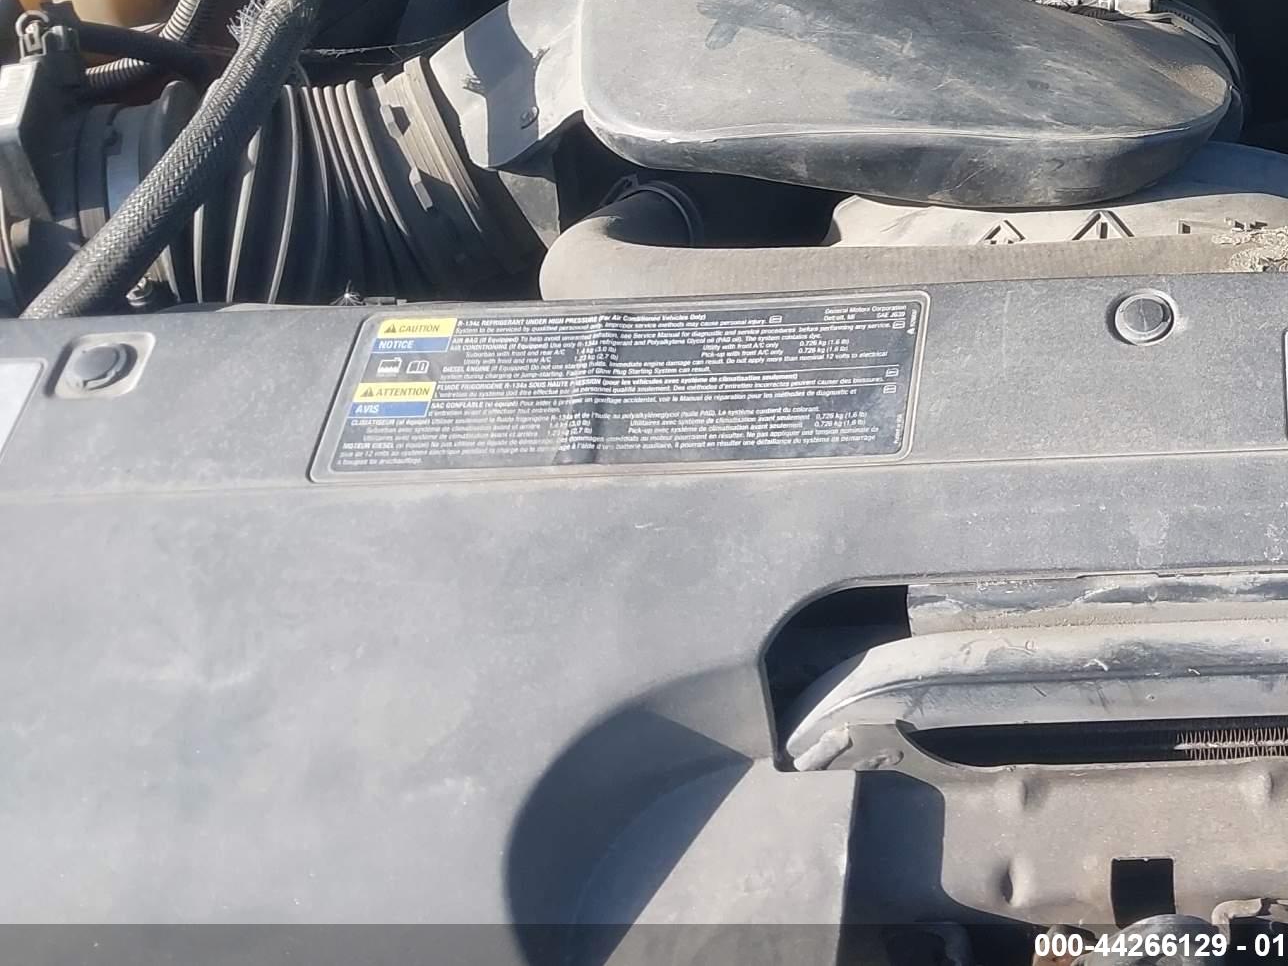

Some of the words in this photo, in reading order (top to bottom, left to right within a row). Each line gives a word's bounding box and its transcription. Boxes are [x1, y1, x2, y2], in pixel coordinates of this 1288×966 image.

[398, 324, 440, 333] CAUTION
[378, 340, 414, 349] NOTICE
[375, 387, 430, 396] ATTENTION
[354, 404, 380, 414] AVIS
